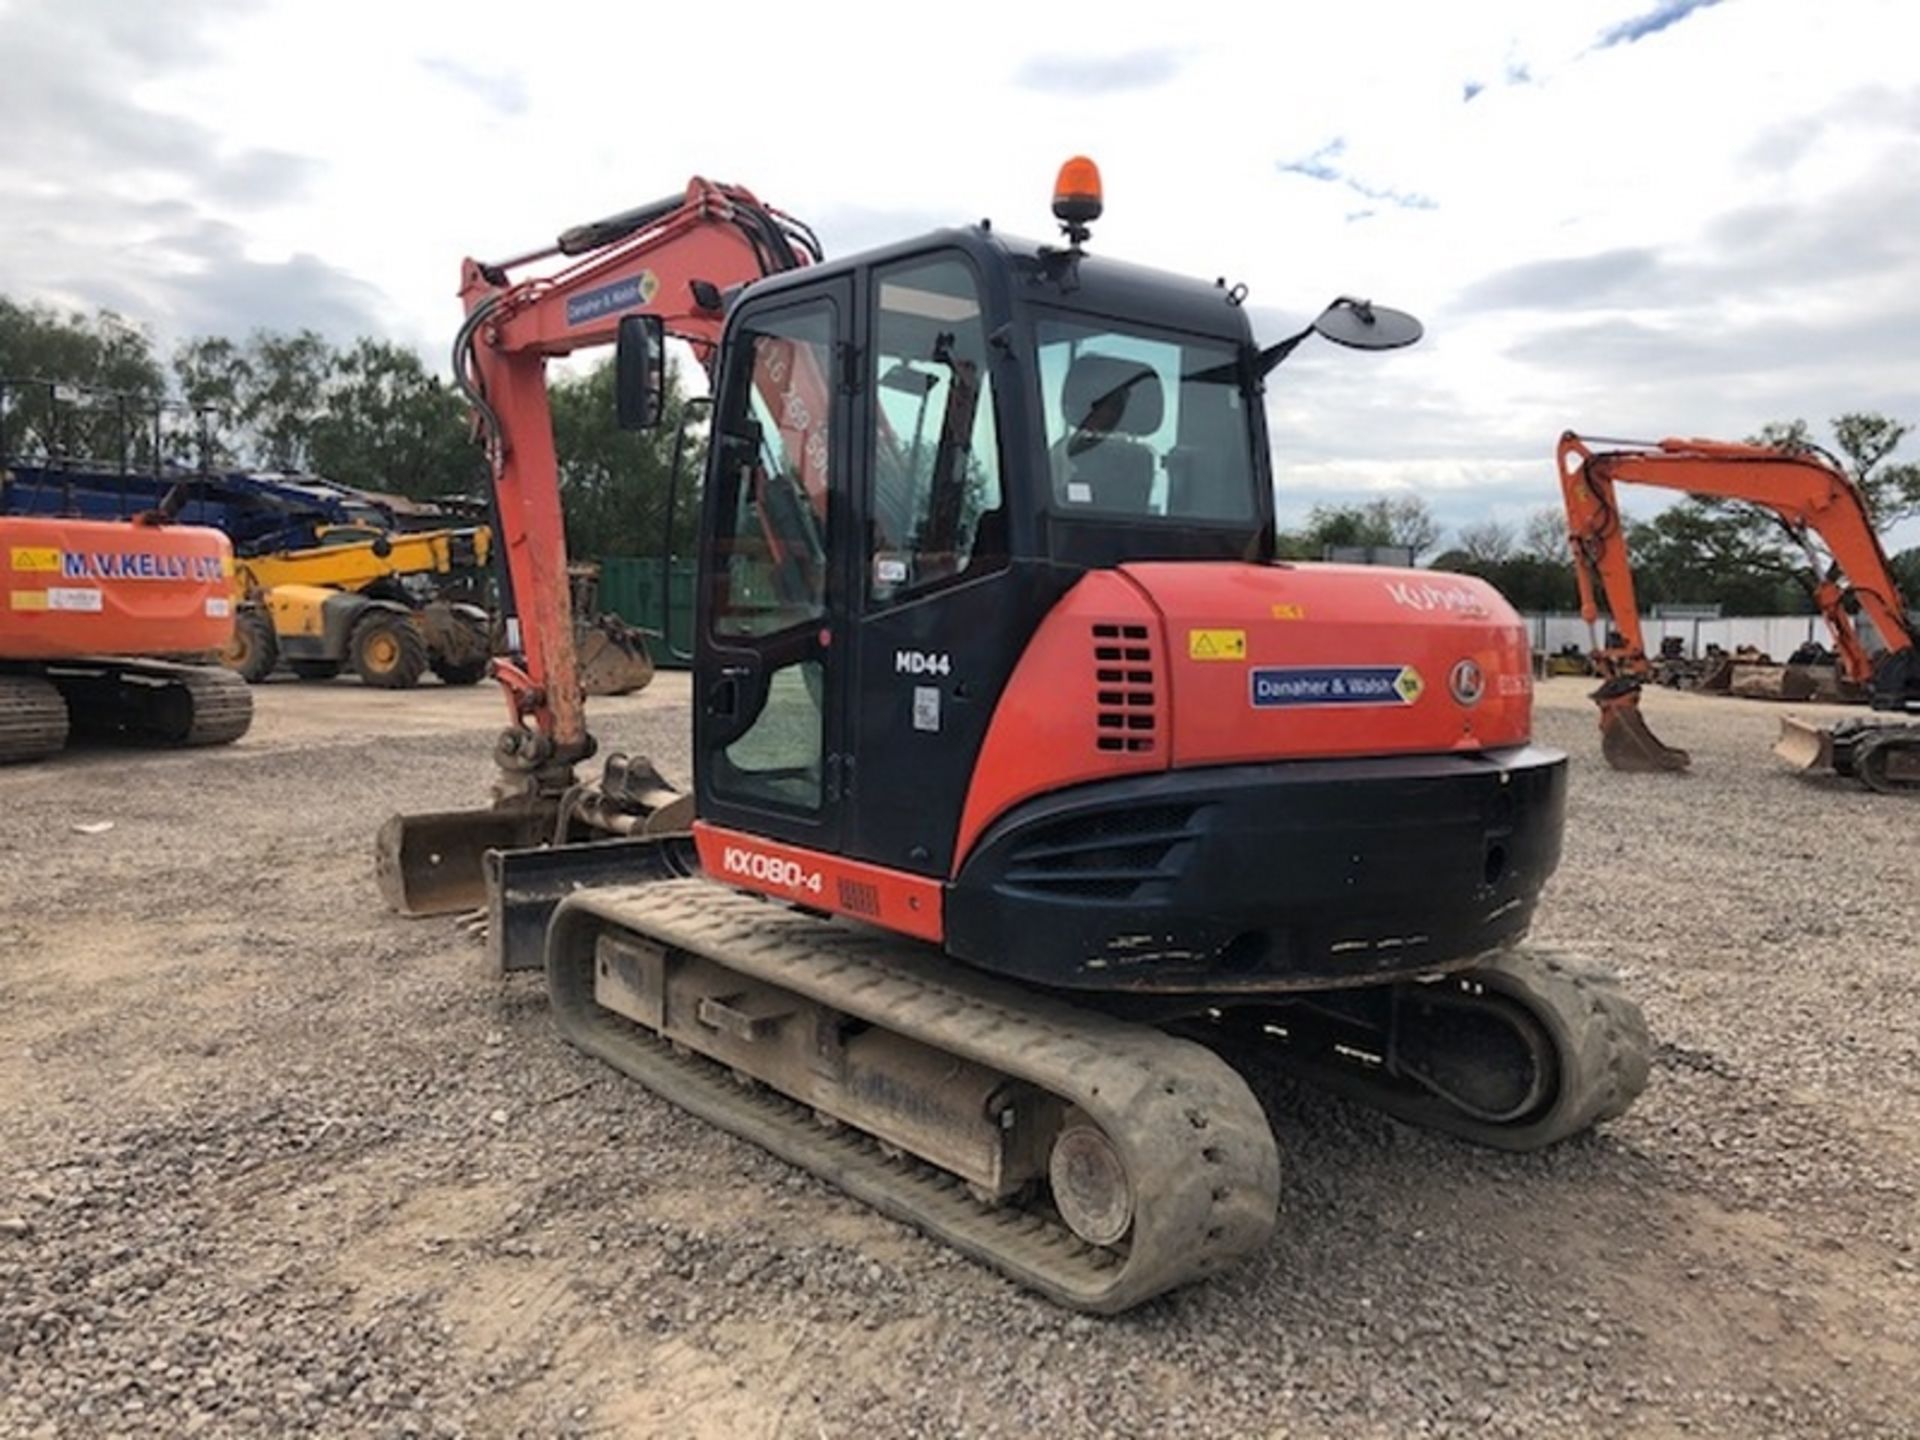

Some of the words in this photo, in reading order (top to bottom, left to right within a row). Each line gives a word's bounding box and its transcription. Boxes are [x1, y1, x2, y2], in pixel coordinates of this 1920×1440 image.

[192, 557, 223, 583] LTD
[895, 650, 951, 676] MD44
[1257, 679, 1328, 697] Danaher
[1331, 678, 1345, 694] &
[1346, 677, 1391, 696] Walsh
[723, 847, 823, 894] KX080-4
